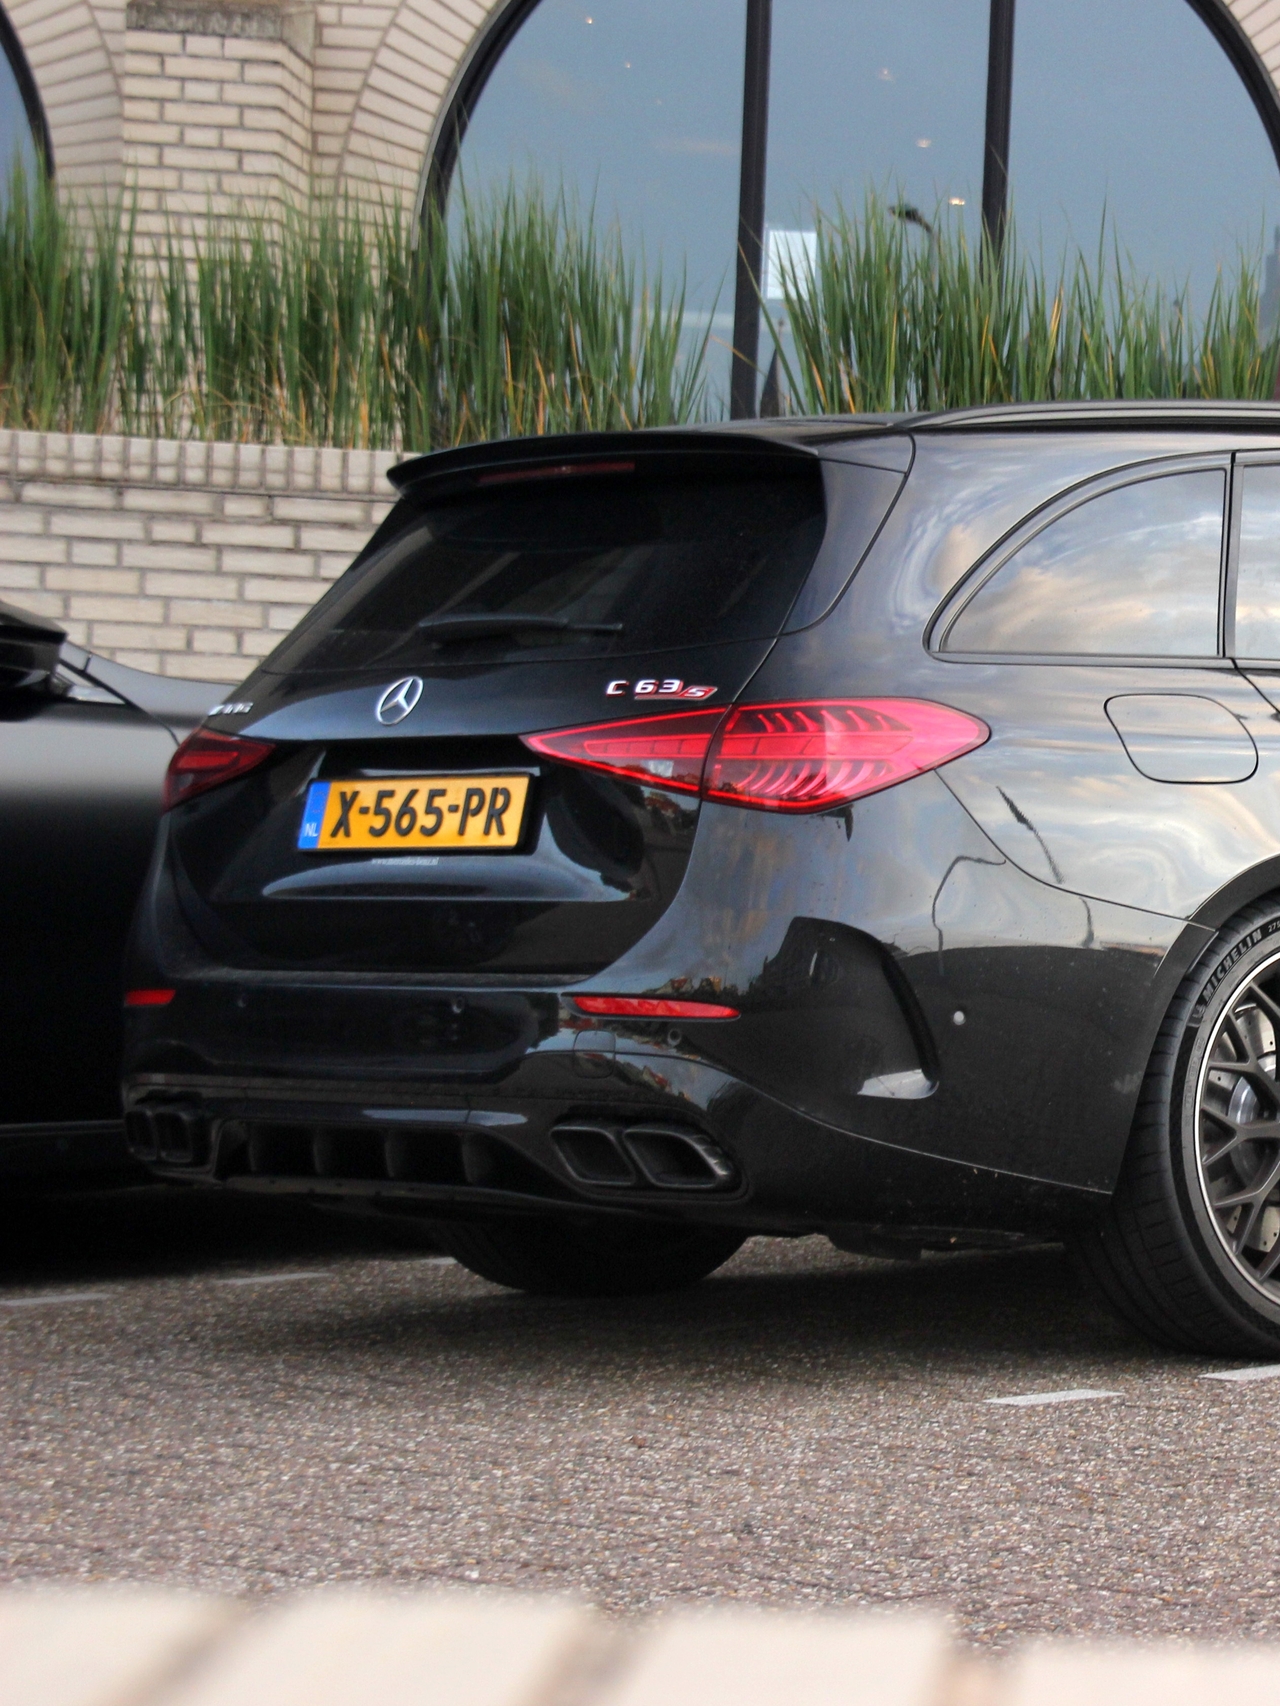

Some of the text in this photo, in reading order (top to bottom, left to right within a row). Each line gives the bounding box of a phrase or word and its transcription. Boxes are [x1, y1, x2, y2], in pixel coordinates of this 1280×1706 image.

[605, 680, 629, 697] C
[329, 787, 512, 838] X-565-PR
[304, 823, 319, 838] NL
[1203, 928, 1263, 1001] MICHELIN
